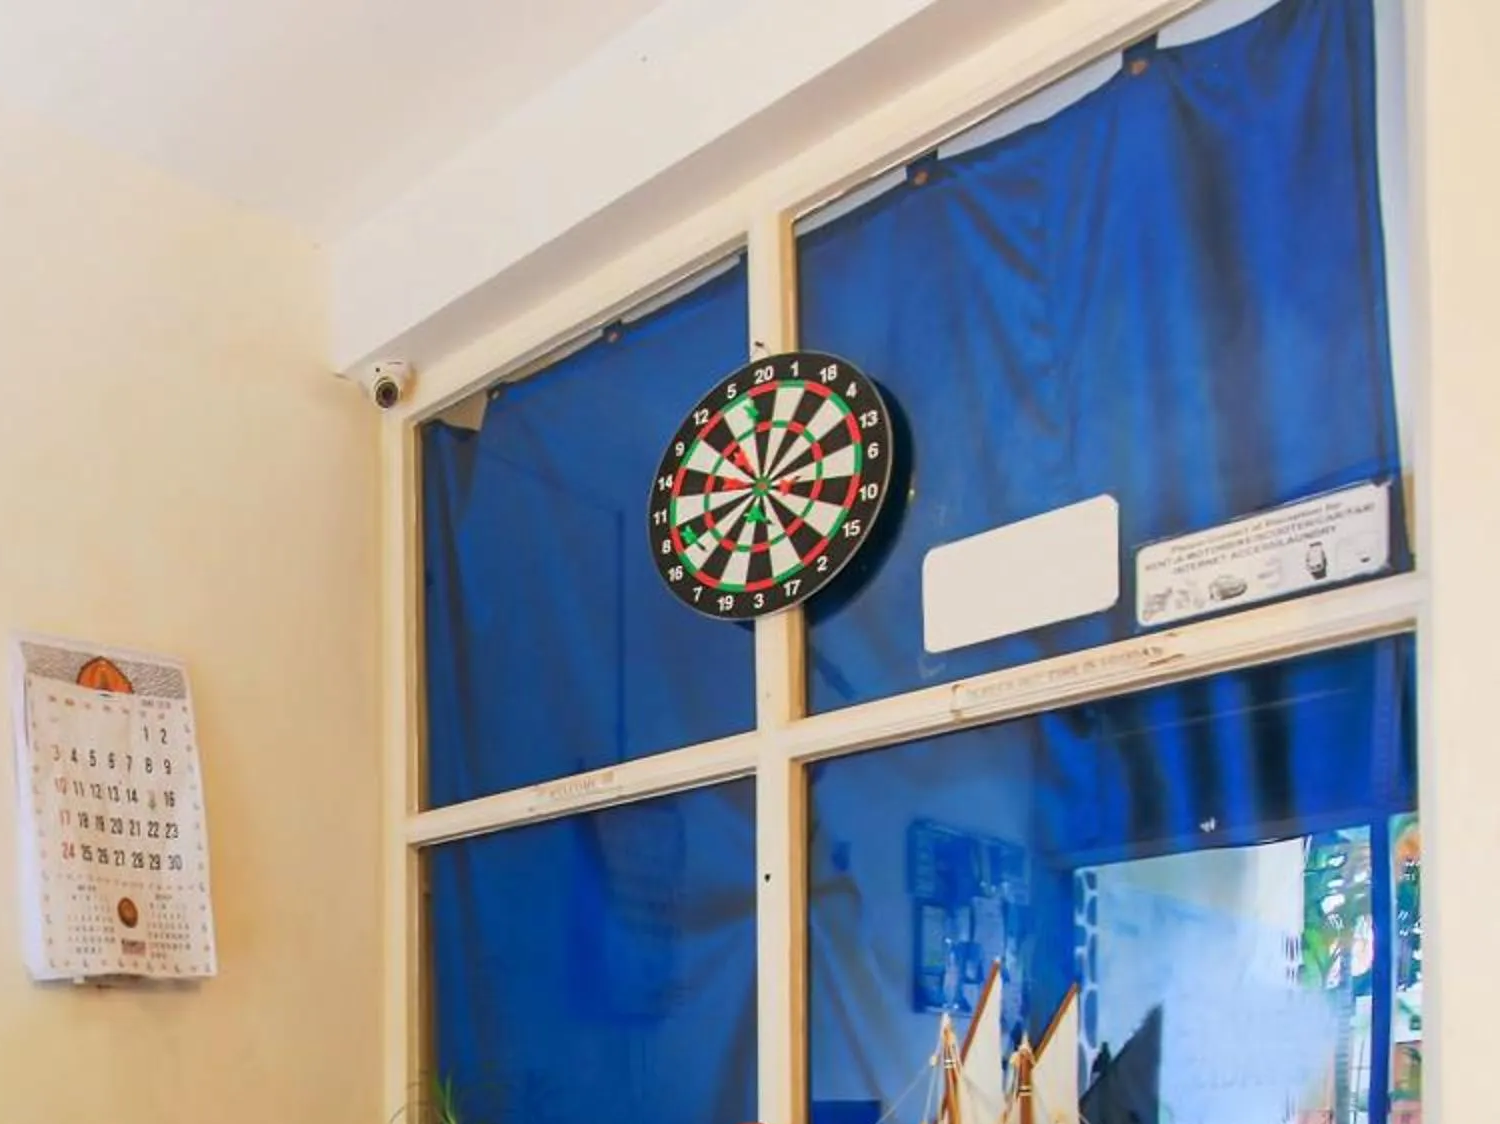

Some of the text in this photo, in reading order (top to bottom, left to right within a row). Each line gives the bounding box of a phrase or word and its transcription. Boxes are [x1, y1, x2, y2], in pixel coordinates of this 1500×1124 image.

[754, 366, 774, 384] 20
[790, 361, 799, 377] 1
[819, 364, 838, 384] 18
[727, 383, 737, 399] 5
[845, 382, 857, 397] 4
[693, 408, 710, 425] 12
[859, 410, 878, 428] 13
[675, 442, 685, 456] 9
[867, 443, 879, 459] 6
[658, 474, 673, 490] 14
[859, 483, 879, 500] 10
[653, 509, 668, 524] 11
[842, 519, 861, 538] 15
[662, 540, 672, 554] 8
[817, 556, 829, 573] 2
[667, 565, 684, 582] 16
[693, 586, 703, 602] 7
[783, 579, 801, 597] 17
[717, 595, 734, 613] 19
[754, 593, 765, 609] 3
[143, 724, 168, 745] 1 2
[50, 744, 172, 775] 3 4 5 6 7 8 9
[73, 780, 84, 797] 11
[90, 783, 102, 800] 12
[108, 785, 119, 802] 13
[126, 788, 138, 803] 14
[163, 791, 175, 808] 16
[78, 812, 89, 829] 18
[110, 817, 123, 835] 20
[129, 819, 141, 836] 21
[147, 820, 159, 839] 22
[165, 822, 179, 839] 23
[62, 841, 183, 870] 24 25 26 27 28 29 30
